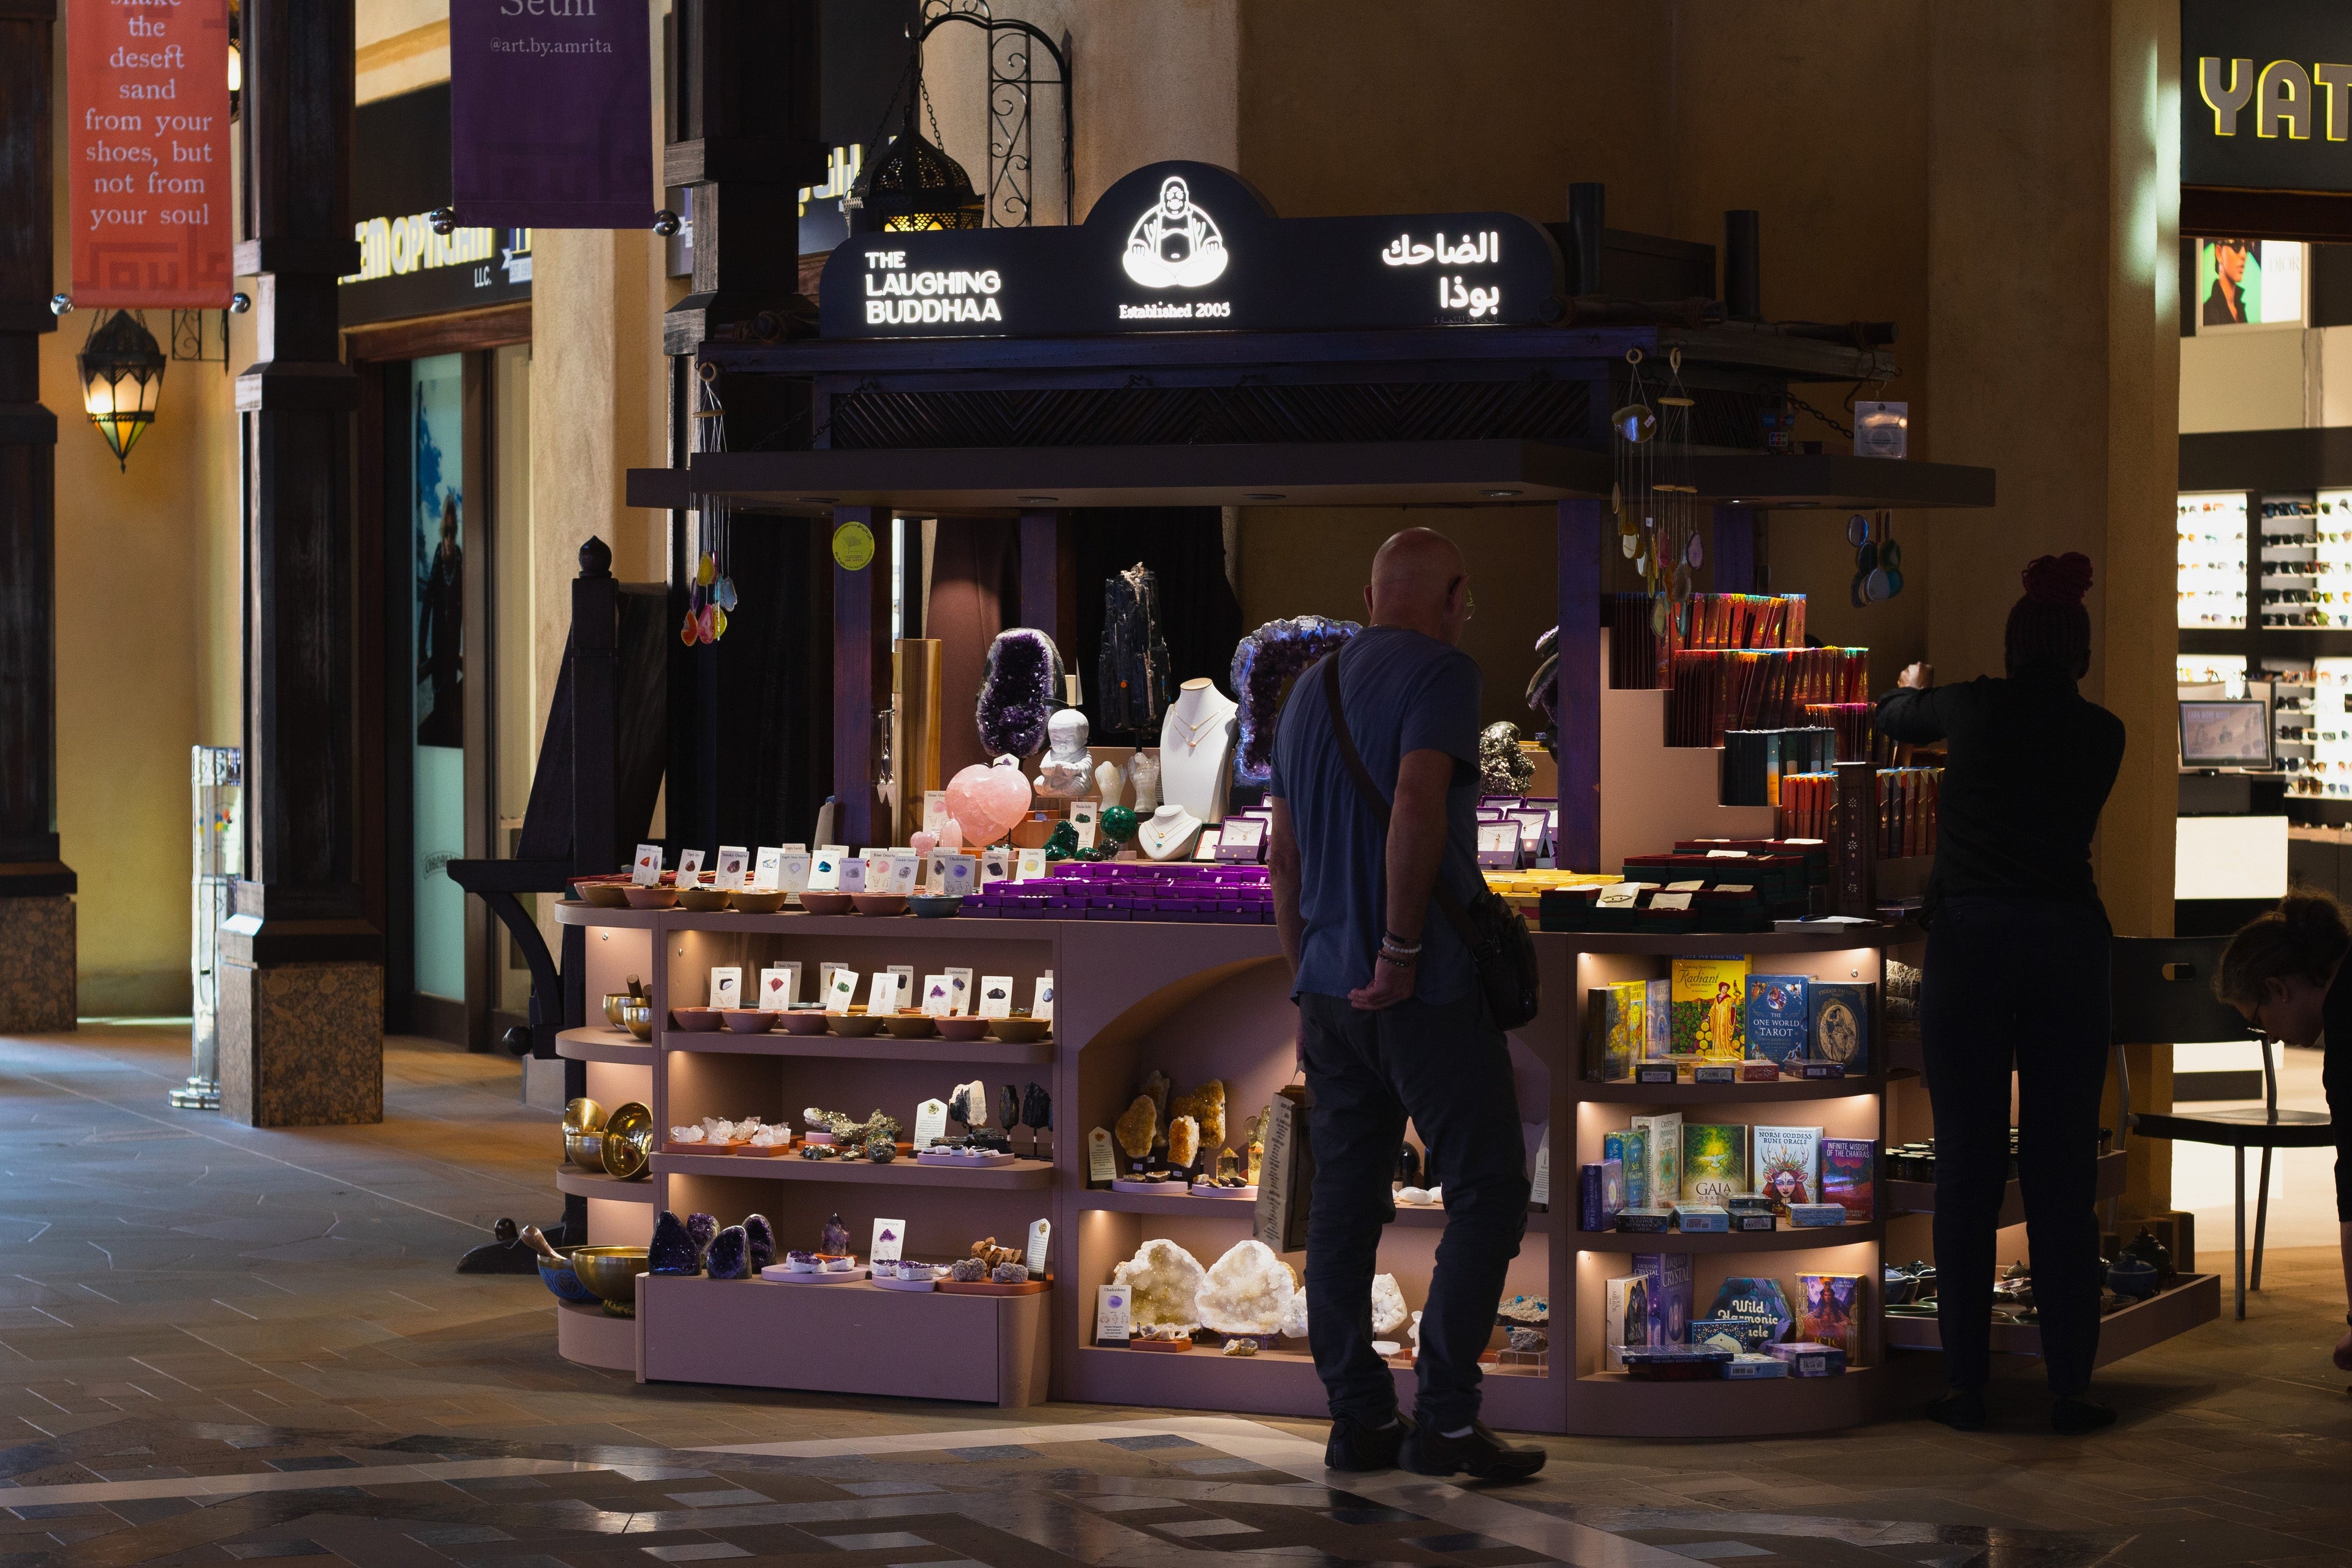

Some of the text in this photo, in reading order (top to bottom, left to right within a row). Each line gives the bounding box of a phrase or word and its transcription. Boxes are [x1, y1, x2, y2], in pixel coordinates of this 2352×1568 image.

[129, 15, 165, 37] the
[110, 44, 184, 69] desert
[490, 37, 612, 57] @art.by.amrita
[119, 78, 176, 99] sand
[86, 108, 213, 137] from your
[86, 140, 213, 167] shoes, but
[94, 171, 205, 194] not from
[91, 203, 209, 231] your soul
[865, 251, 906, 269] THE
[1382, 232, 1499, 266] الضاحك
[865, 270, 1001, 296] LAUGHING
[1440, 276, 1499, 317] بوذا
[866, 298, 1002, 324] BUDDHAA
[1119, 301, 1231, 318] Established 2005
[1676, 970, 1721, 989] Radiant
[1695, 1182, 1732, 1196] GAIA
[1662, 1267, 1691, 1287] CRYSTAL
[1732, 1300, 1765, 1314] Wild
